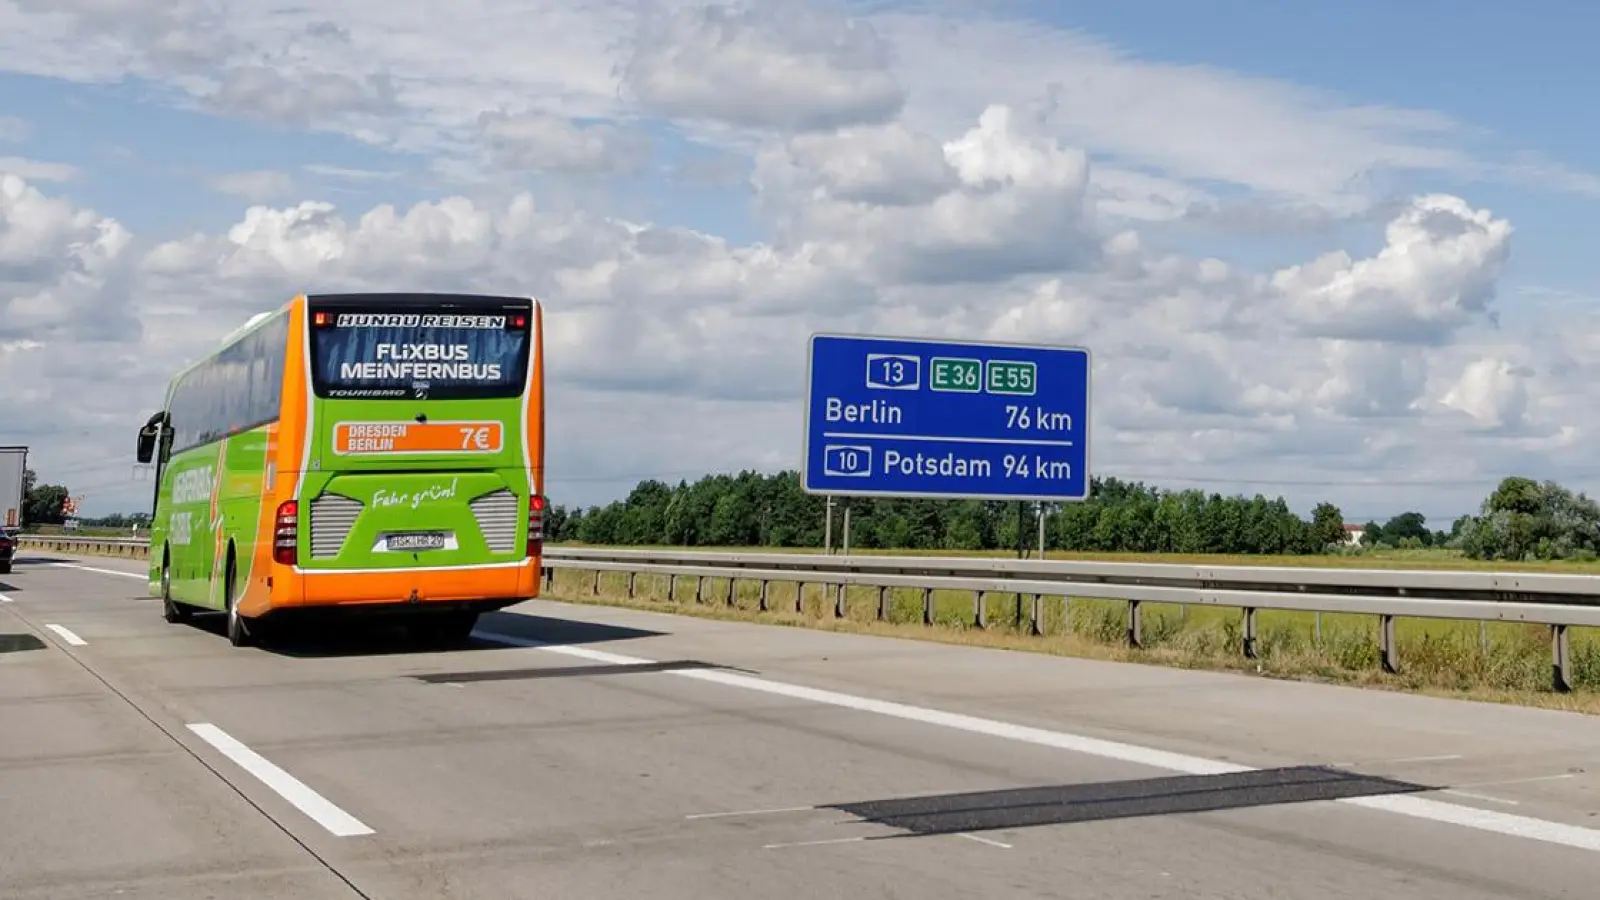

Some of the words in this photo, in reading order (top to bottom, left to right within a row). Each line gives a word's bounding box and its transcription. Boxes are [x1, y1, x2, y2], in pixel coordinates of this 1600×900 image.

[337, 313, 419, 327] HUNAU
[421, 315, 506, 328] REISEN
[883, 361, 904, 383] 13
[935, 364, 949, 384] E
[952, 365, 976, 386] 36
[991, 366, 1004, 387] E
[1007, 368, 1031, 389] 55
[328, 388, 406, 397] TOURISMO
[825, 397, 902, 424] Berlin
[1005, 405, 1031, 430] 76
[1036, 407, 1072, 431] km
[348, 424, 407, 438] DRESDEN
[459, 427, 490, 449] 7€
[348, 438, 394, 450] BERLIN
[839, 452, 857, 471] 10
[884, 450, 991, 478] Potsdam
[1003, 455, 1030, 479] 94
[1036, 455, 1071, 480] km
[371, 489, 408, 510] Fahr
[412, 477, 459, 510] grün!
